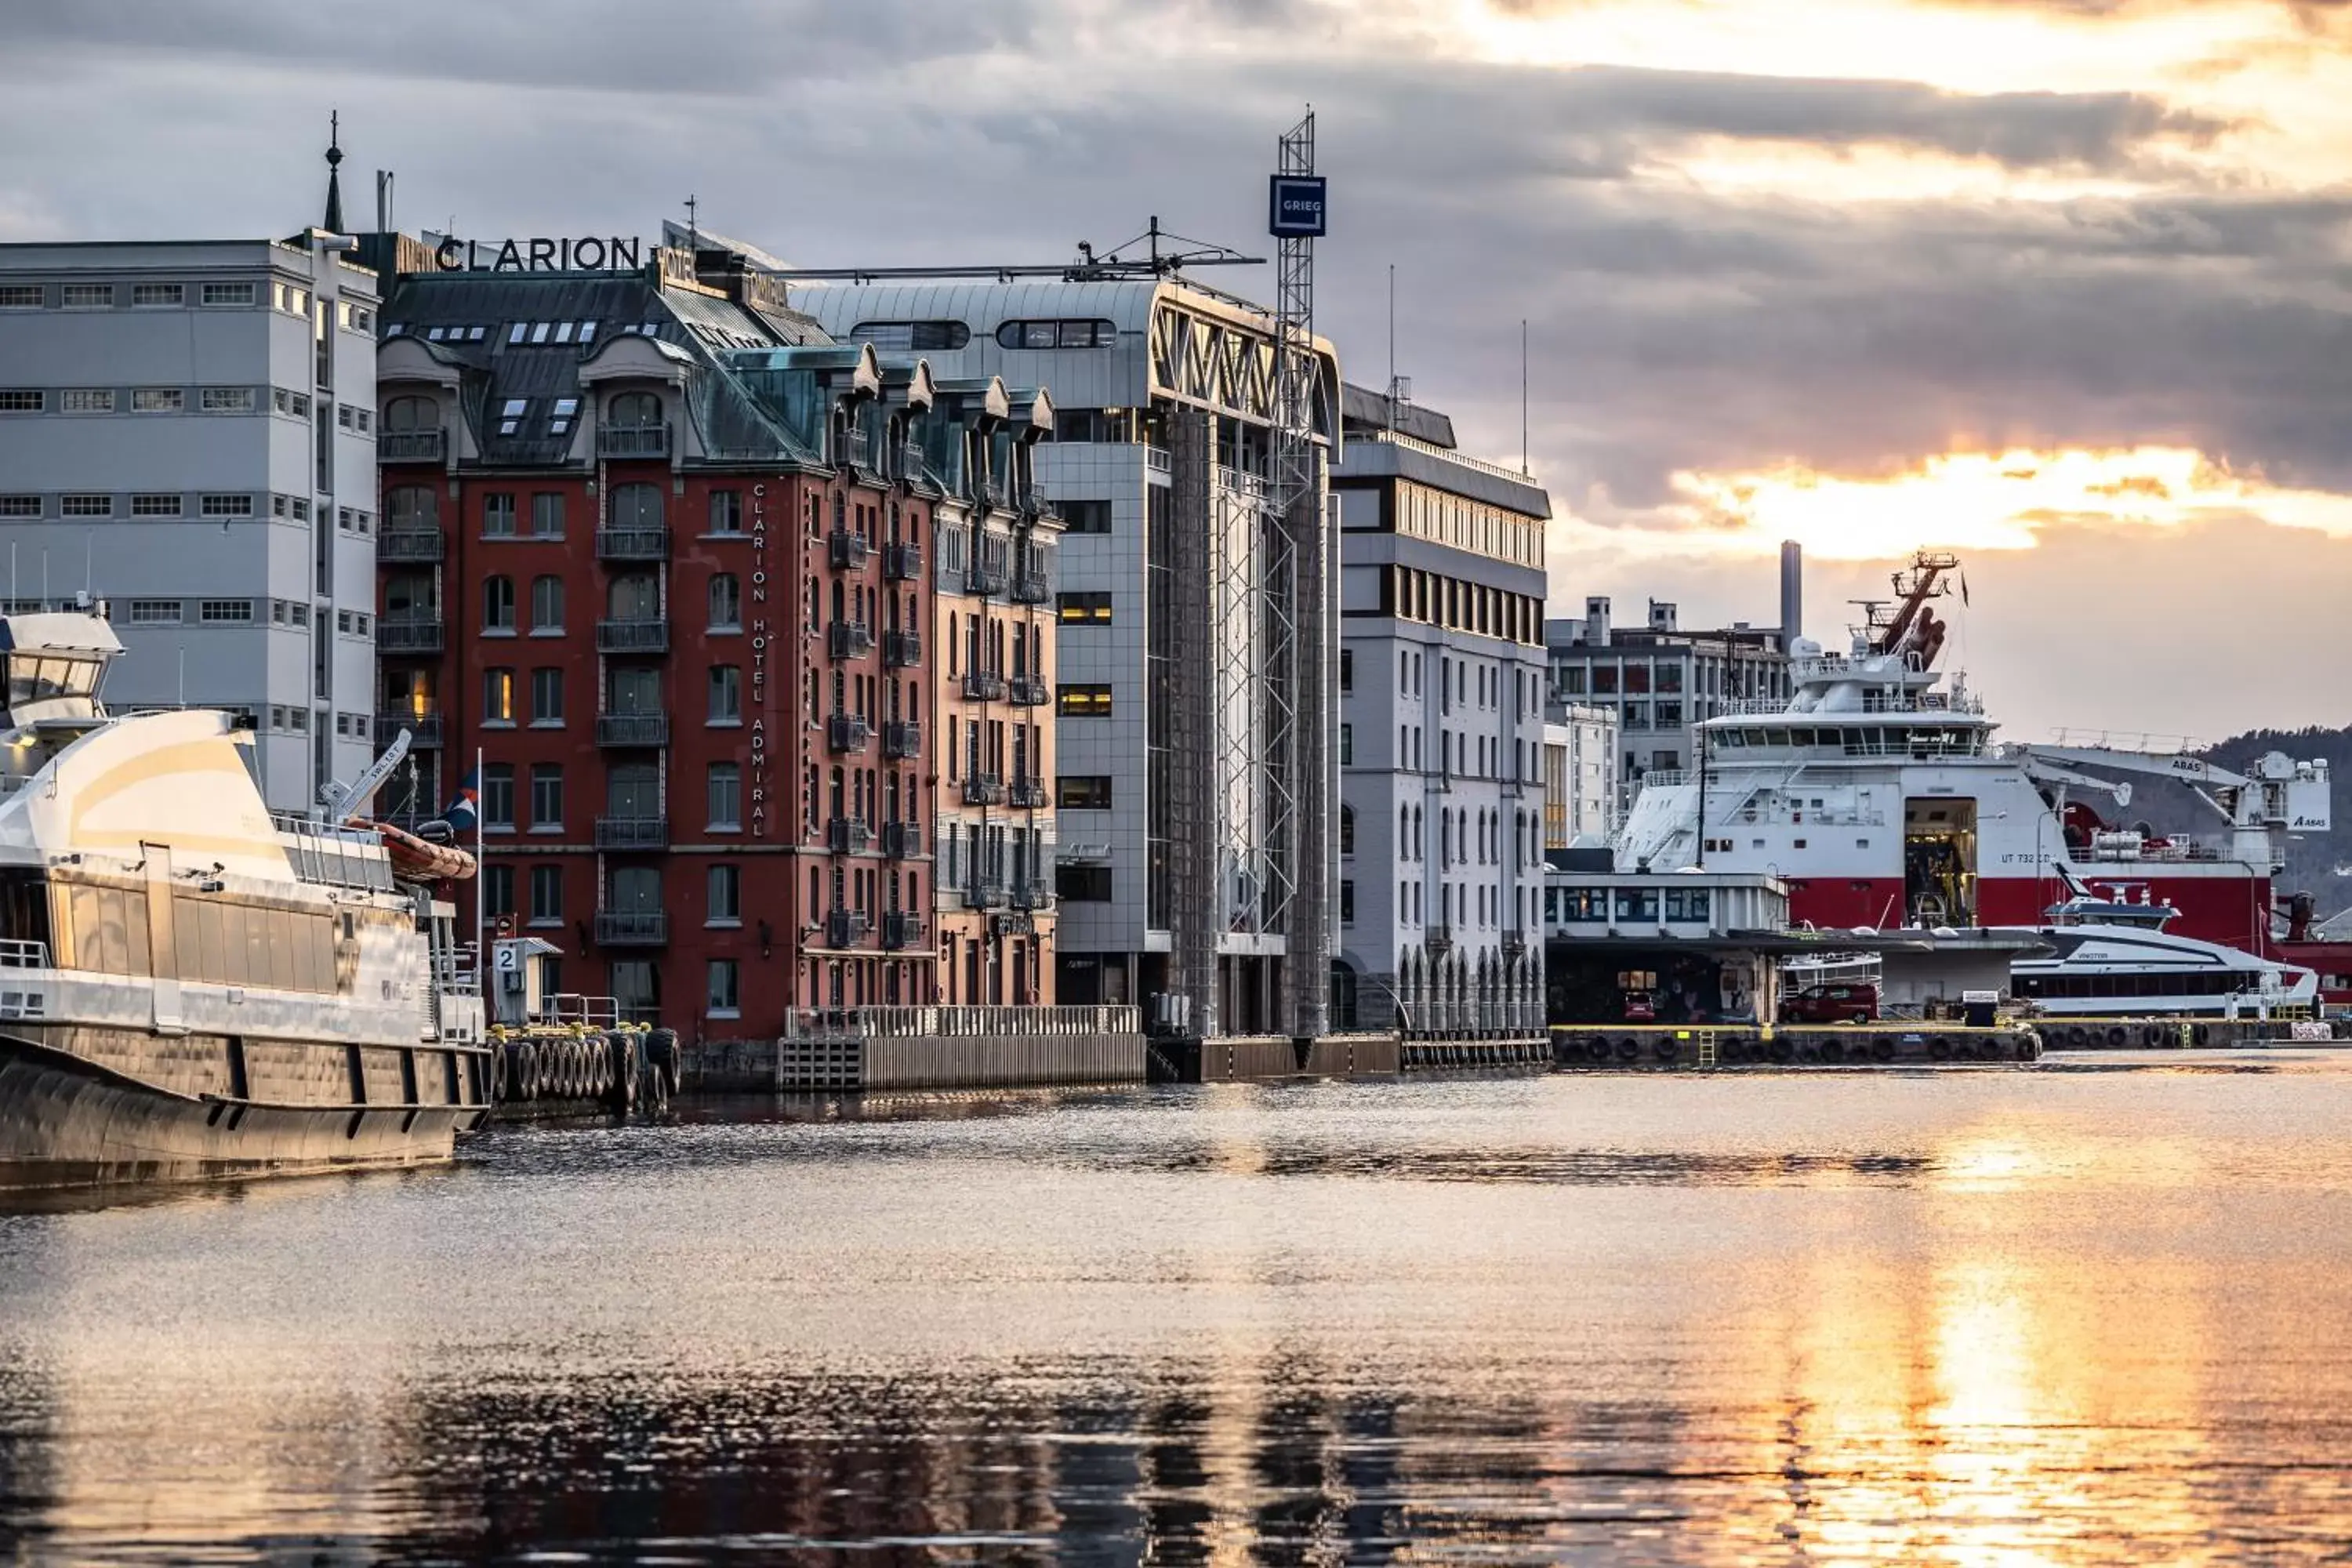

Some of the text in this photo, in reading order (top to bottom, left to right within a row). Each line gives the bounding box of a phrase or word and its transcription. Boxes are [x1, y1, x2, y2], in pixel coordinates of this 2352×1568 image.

[1283, 200, 1321, 211] GRIEG
[435, 237, 639, 272] CLARION
[752, 484, 765, 837] CLARION HOTEL ADMIRAL
[2172, 760, 2201, 772] ABAS
[2001, 854, 2013, 863] UT
[2017, 854, 2034, 863] 732
[500, 949, 514, 967] 2
